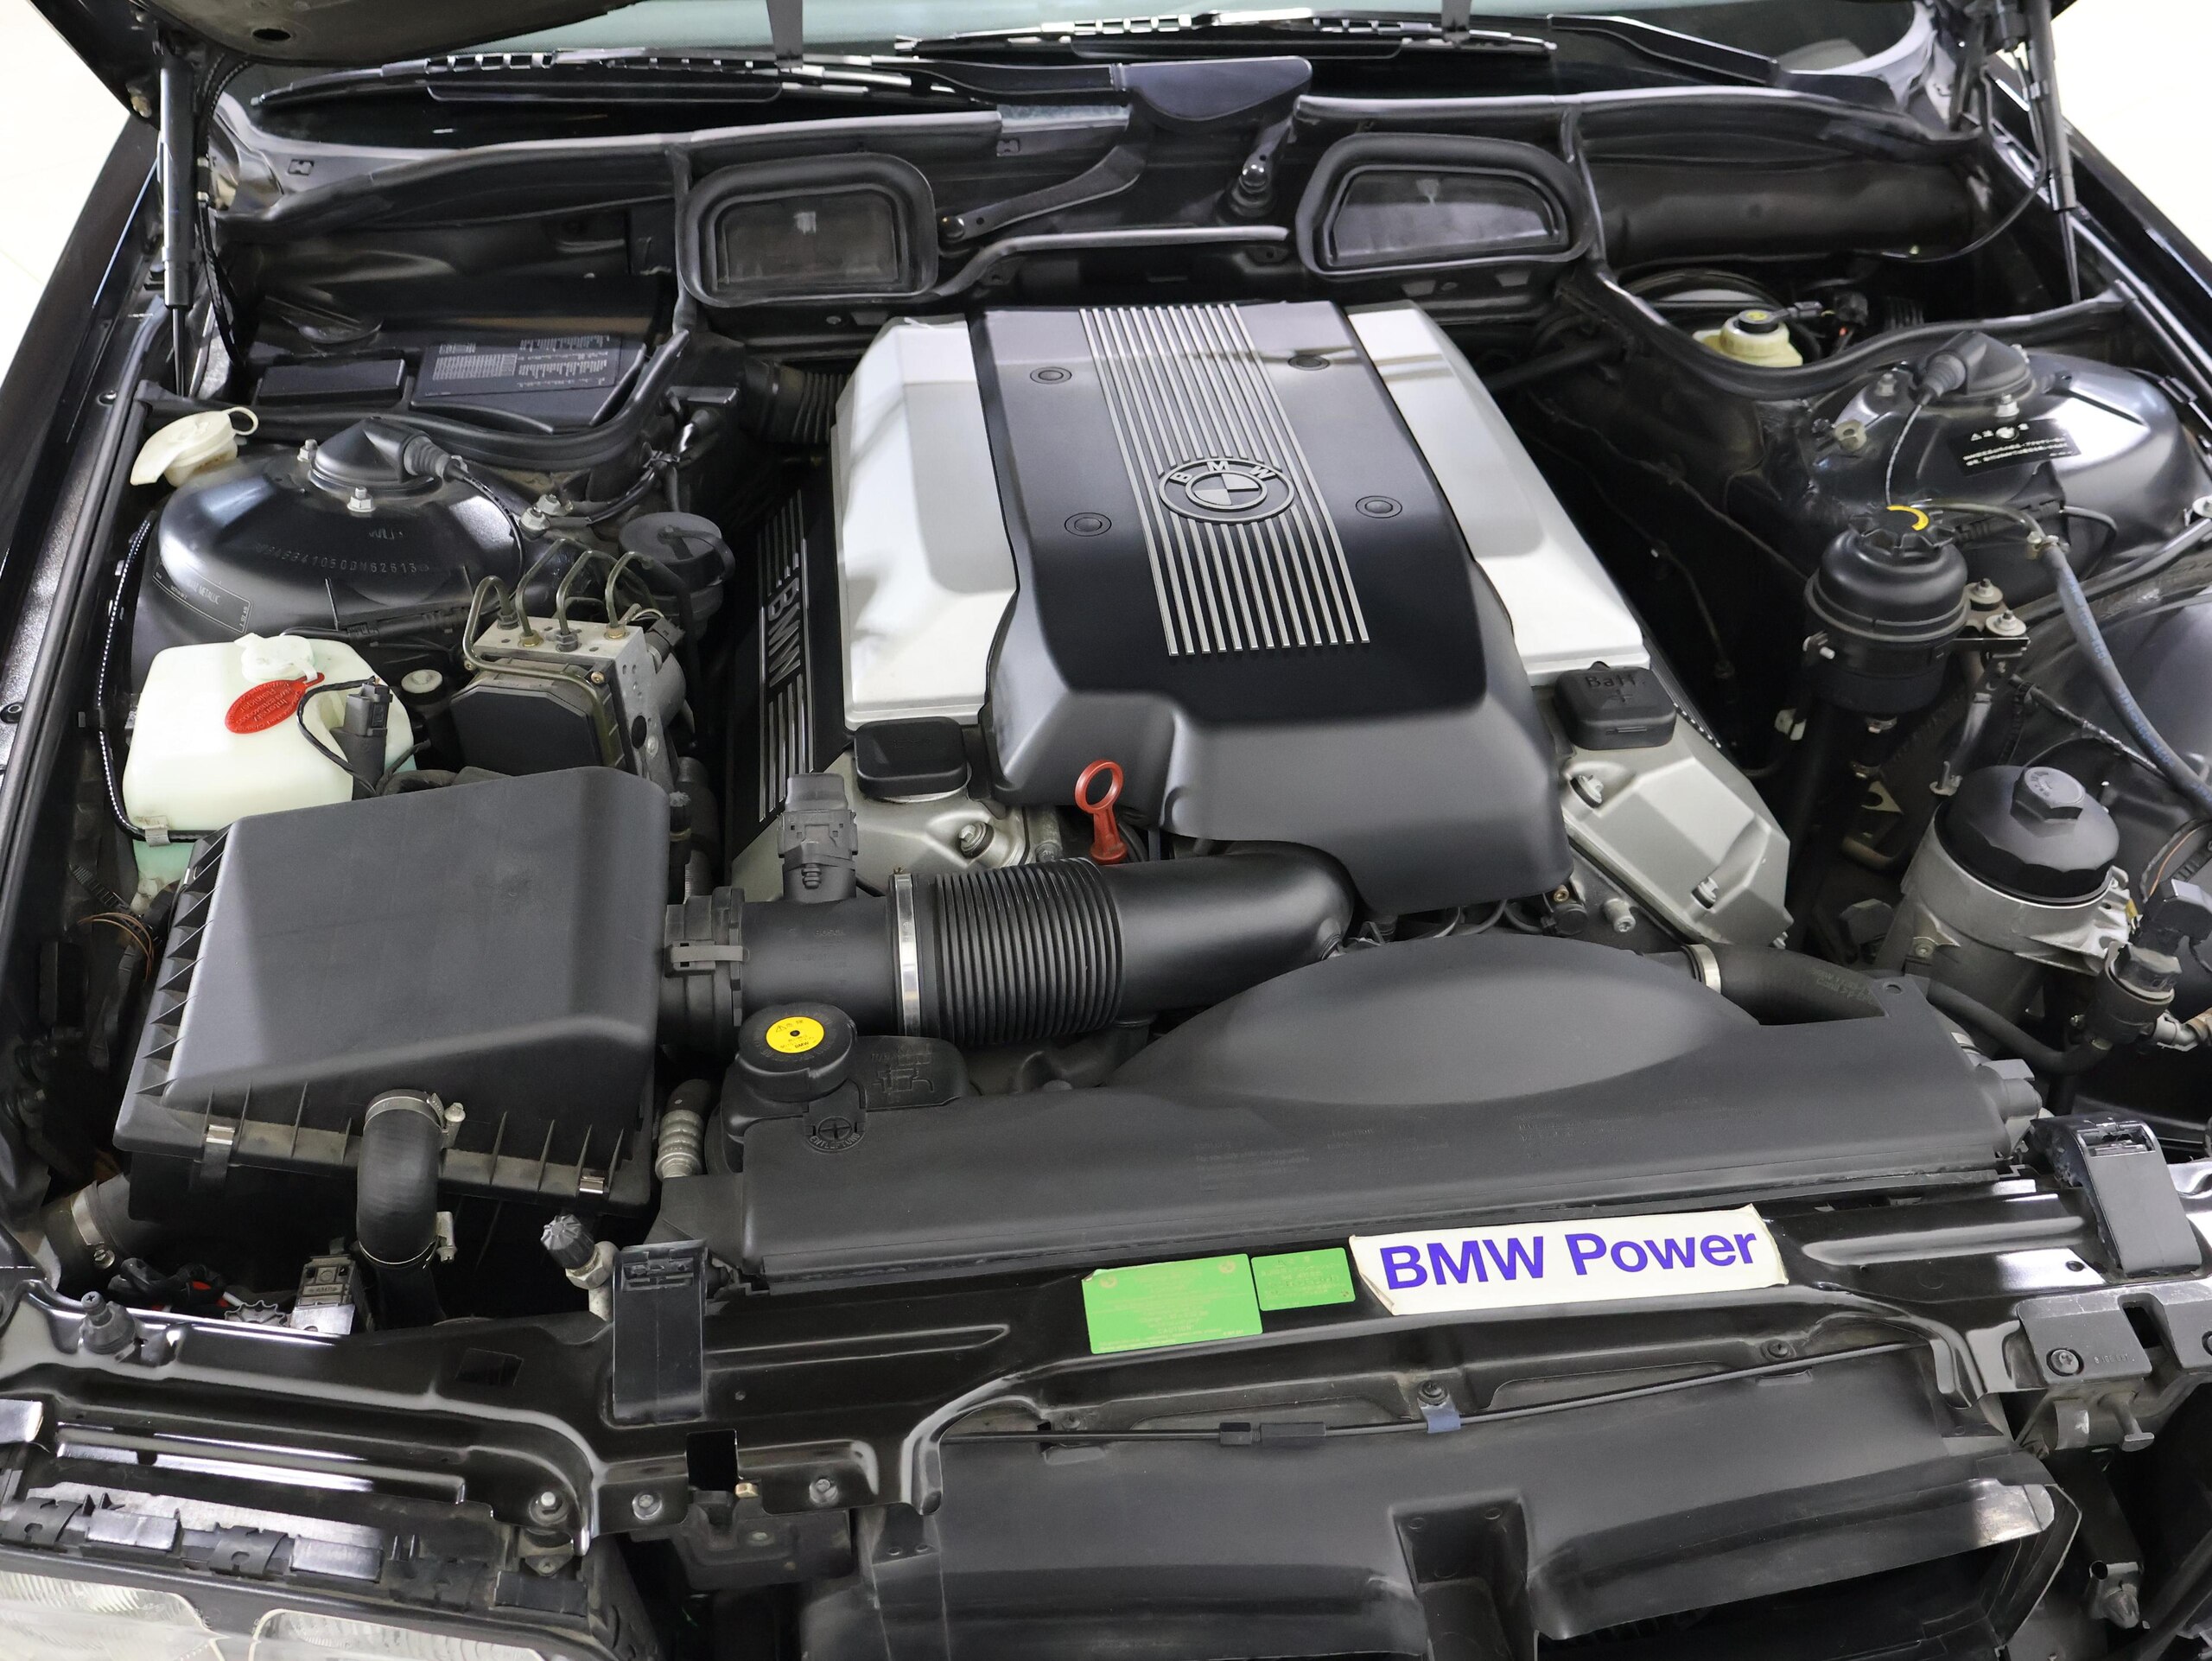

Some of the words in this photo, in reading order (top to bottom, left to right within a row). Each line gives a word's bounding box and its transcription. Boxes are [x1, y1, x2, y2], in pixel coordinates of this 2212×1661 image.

[1169, 461, 1276, 483] BMW
[768, 577, 800, 688] BMW
[1380, 1236, 1543, 1289] BMW
[1564, 1232, 1758, 1276] Power
